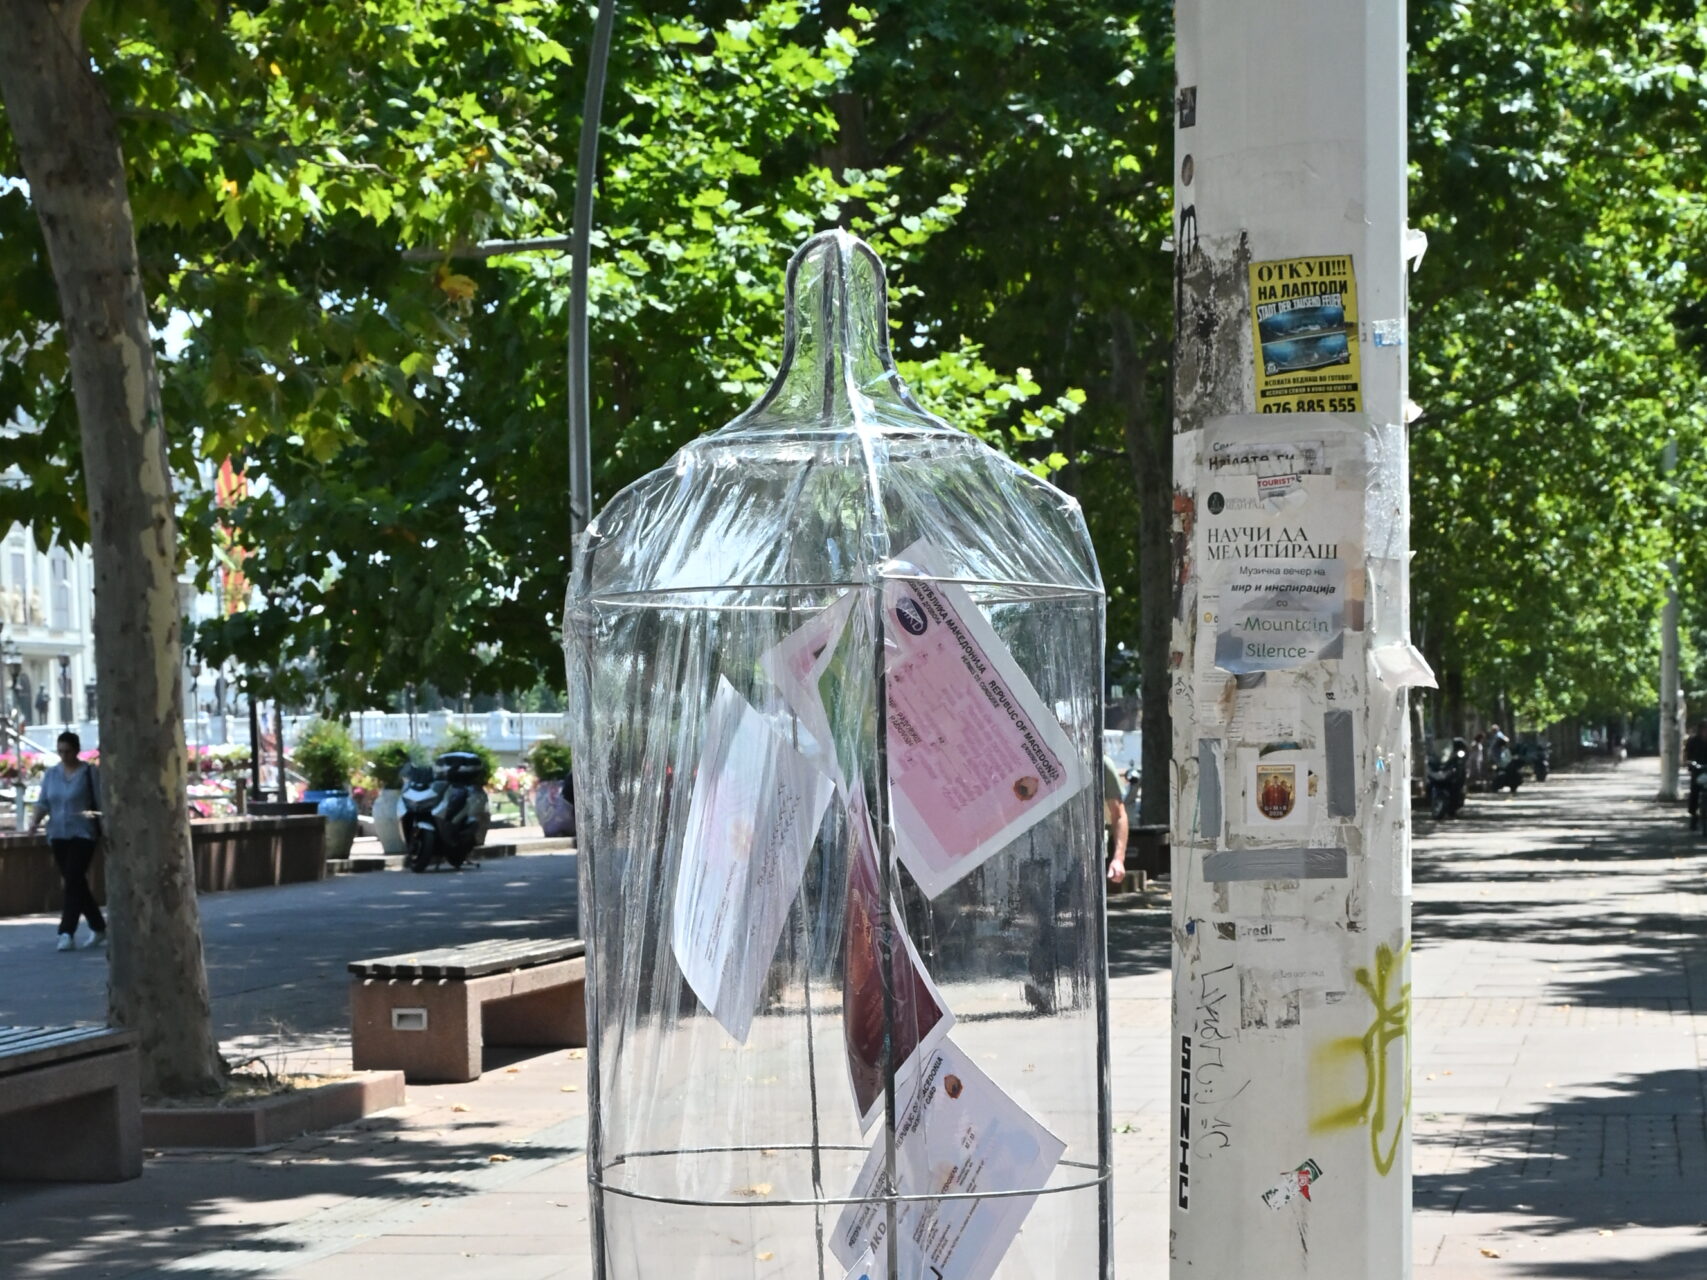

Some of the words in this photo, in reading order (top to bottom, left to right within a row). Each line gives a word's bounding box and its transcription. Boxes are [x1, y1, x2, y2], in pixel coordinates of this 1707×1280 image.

[1257, 260, 1347, 282] ОТКУП!!!
[1258, 286, 1277, 300] НА
[1281, 280, 1347, 298] ЛАПТОПИ
[1263, 402, 1292, 413] 076
[1297, 399, 1325, 413] 885
[1329, 397, 1356, 412] 555
[1207, 527, 1271, 543] НАУЧИ
[1277, 527, 1308, 543] ДА
[1239, 566, 1281, 576] Музичка
[1283, 568, 1312, 576] вечер
[1314, 568, 1326, 576] на
[1231, 584, 1252, 593] мир
[1264, 584, 1336, 595] инспирација
[943, 617, 988, 674] МАКЕДОНИЈА
[987, 680, 1020, 721] REPUBLIC
[1015, 719, 1028, 734] OF
